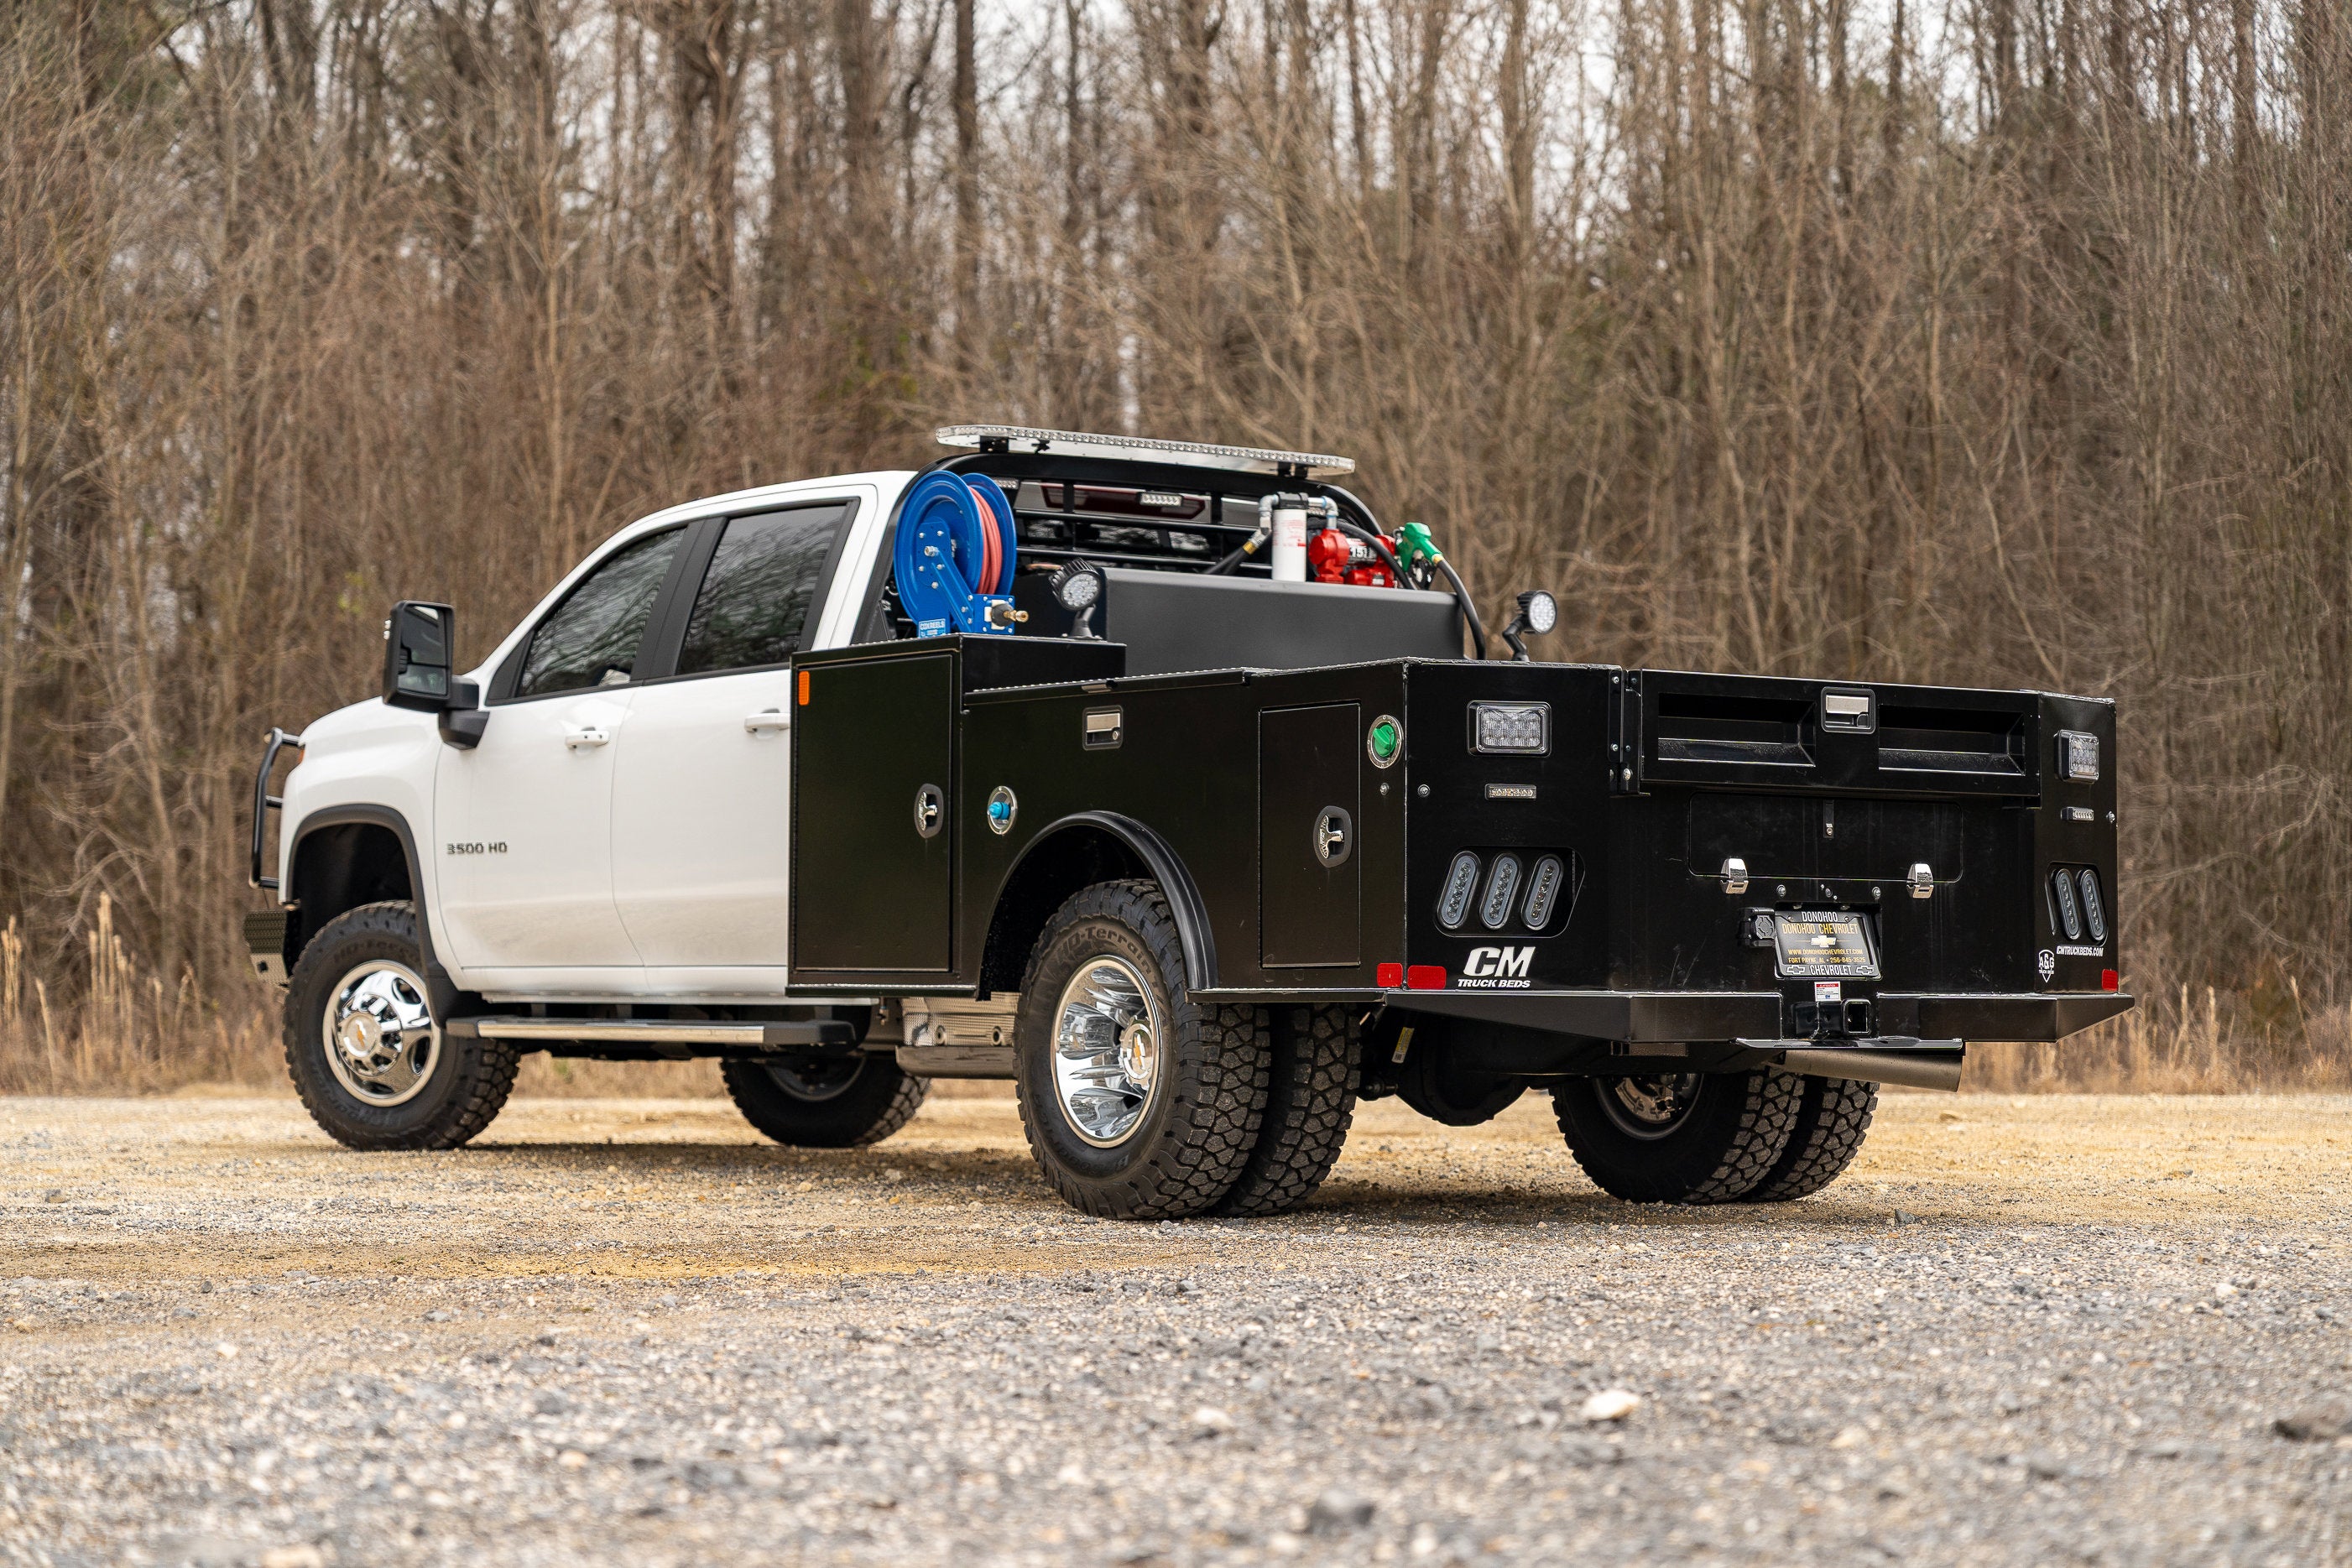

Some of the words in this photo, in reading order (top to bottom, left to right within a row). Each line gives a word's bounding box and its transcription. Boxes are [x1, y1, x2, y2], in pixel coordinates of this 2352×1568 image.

[447, 843, 484, 855] 3500
[488, 841, 508, 853] HD
[1802, 911, 1838, 922] DONOHOO
[1782, 924, 1816, 934] DONOHOO
[1819, 924, 1858, 934] CHEVROLET
[2056, 945, 2104, 956] CMTRUCKBEDS.COM
[1463, 946, 1536, 977] CM
[2039, 953, 2054, 969] A&G
[1810, 965, 1852, 975] CHEVROLET
[1458, 979, 1498, 987] TRUCK
[1498, 980, 1531, 988] BEDS
